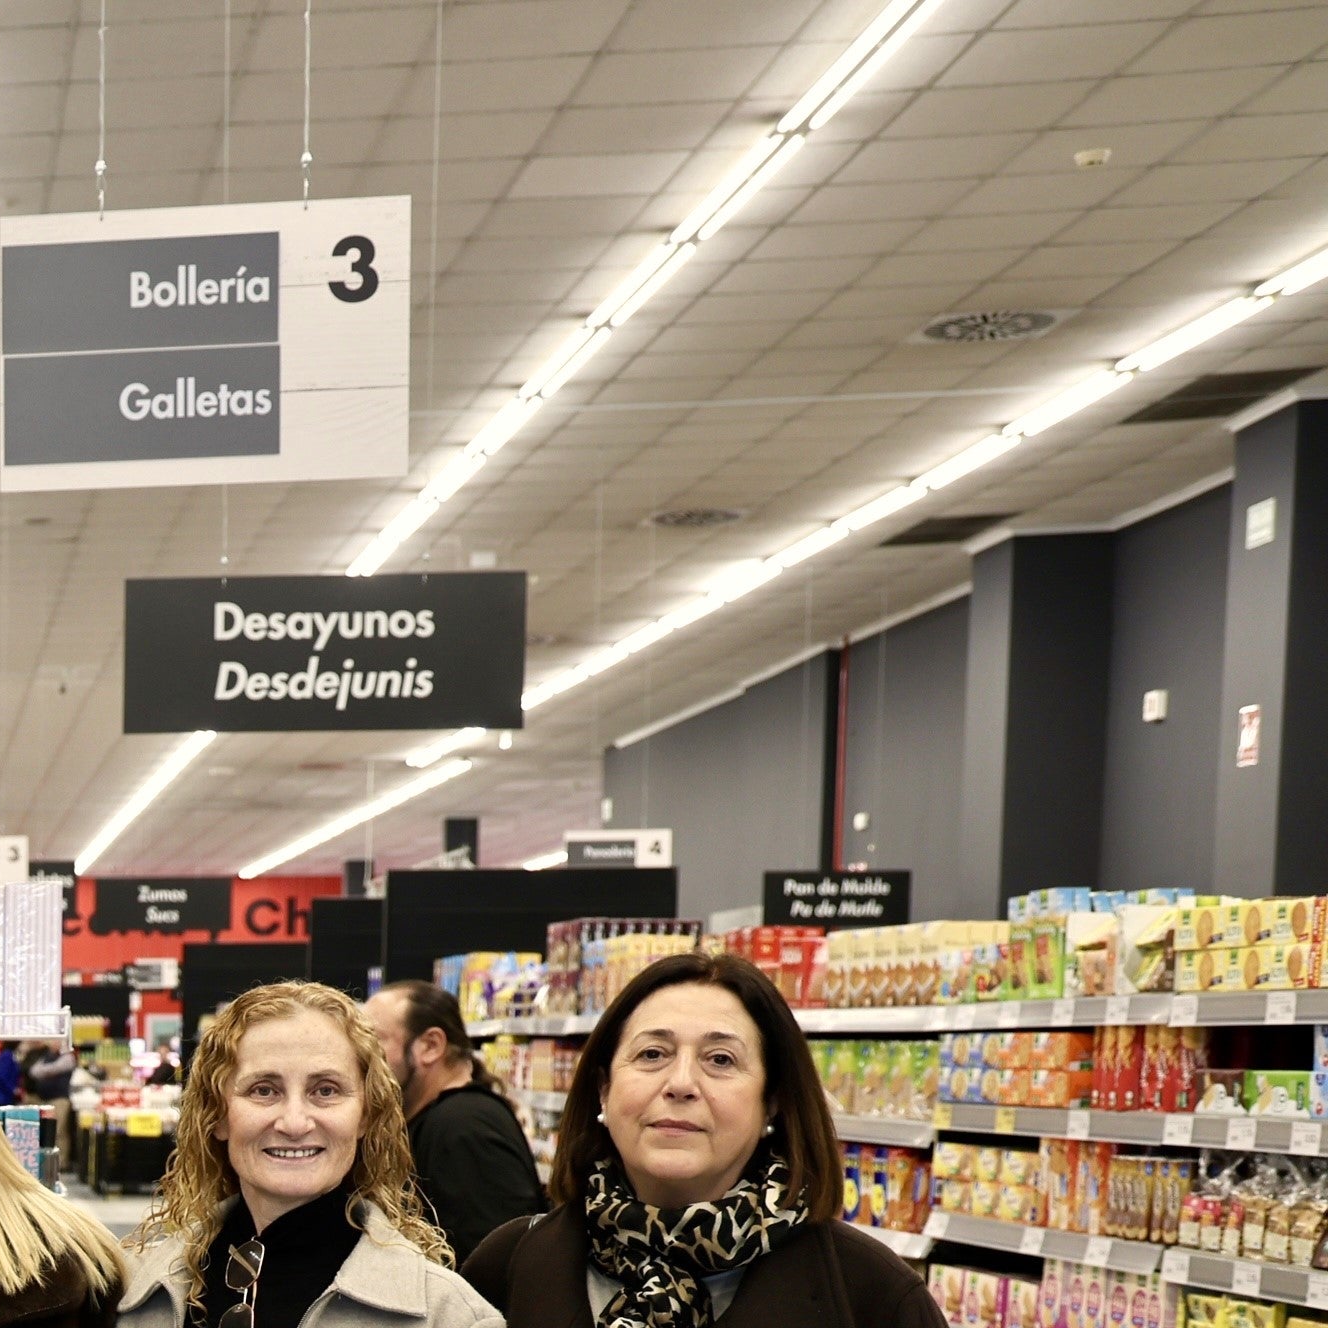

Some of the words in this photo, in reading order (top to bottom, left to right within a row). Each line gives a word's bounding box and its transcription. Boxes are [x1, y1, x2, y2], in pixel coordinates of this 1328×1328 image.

[129, 264, 271, 308] Bollería
[327, 235, 380, 304] 3
[118, 377, 272, 421] Galletas
[213, 601, 436, 651] Desayunos
[213, 655, 434, 711] Desdejunis
